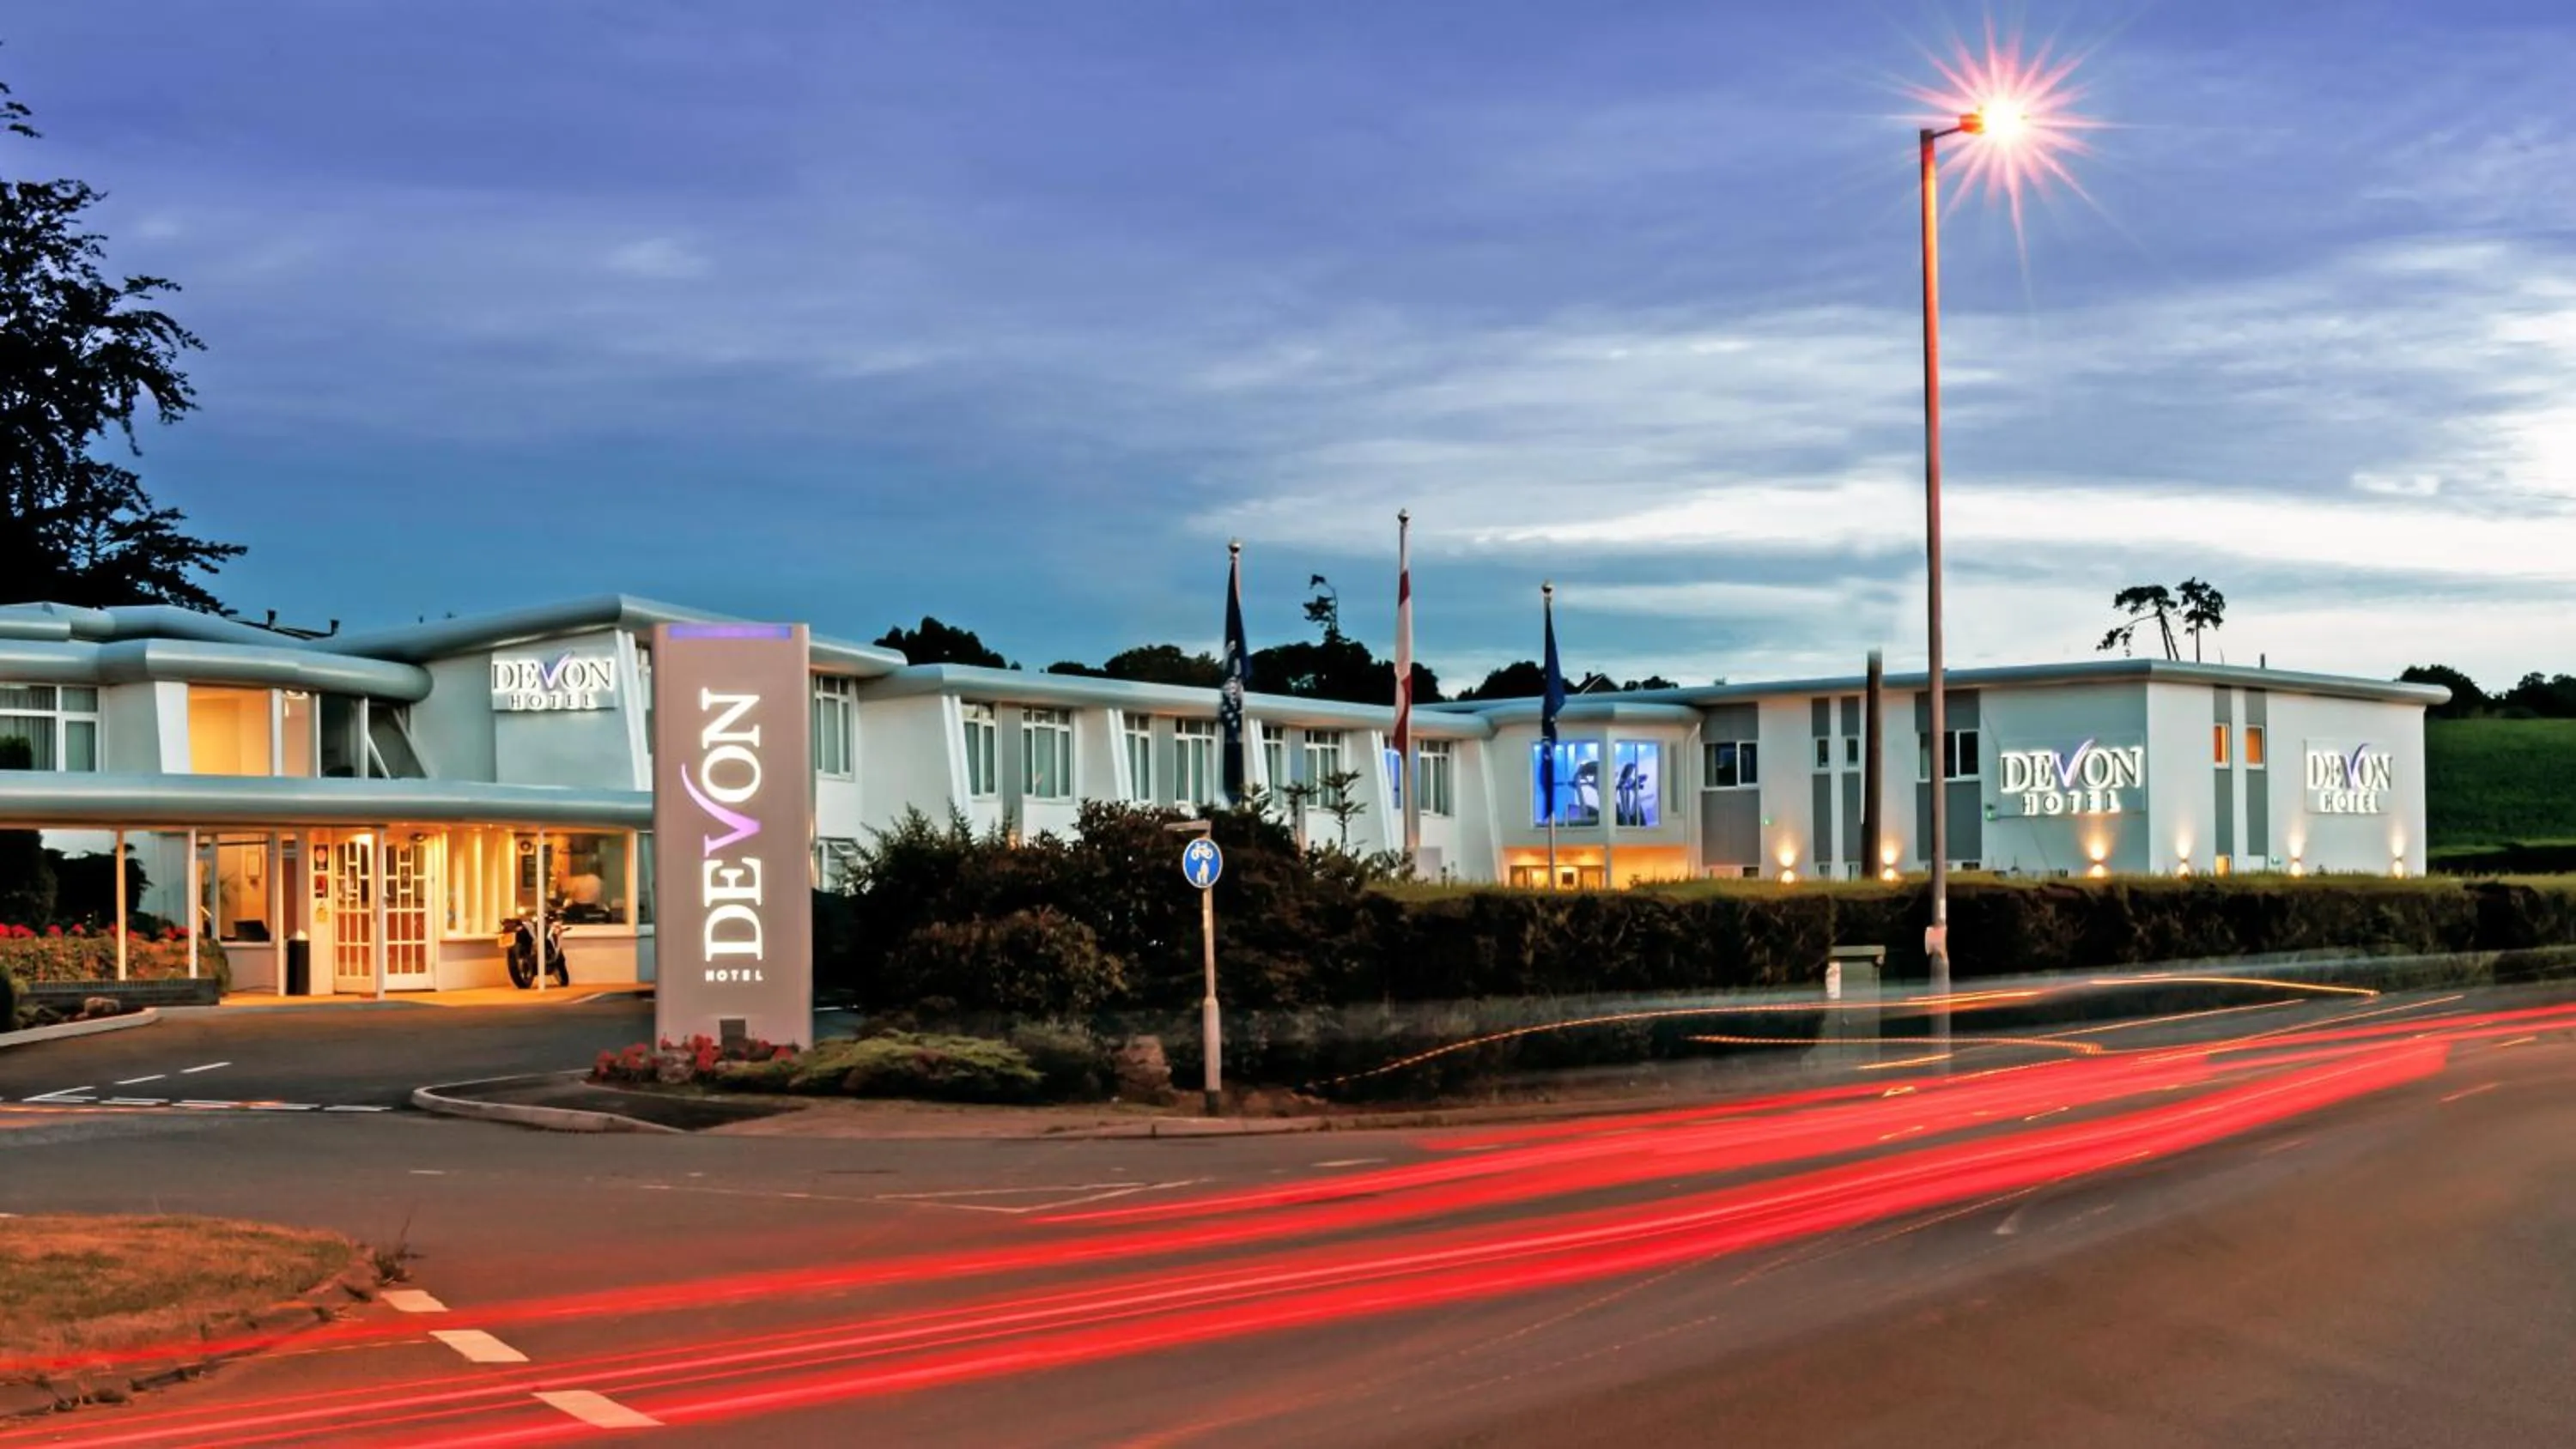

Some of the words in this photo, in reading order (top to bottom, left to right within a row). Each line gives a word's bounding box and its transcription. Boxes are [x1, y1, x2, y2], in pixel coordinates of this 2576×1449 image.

[491, 649, 615, 693] DEVON
[510, 691, 598, 710] HOTEL
[2001, 738, 2144, 794] DEVON
[2306, 743, 2393, 791] DEVON
[2022, 790, 2121, 815] HOTEL
[2319, 789, 2380, 814] HOTEL
[680, 687, 762, 961] DEVON
[705, 969, 763, 981] HOTEL
